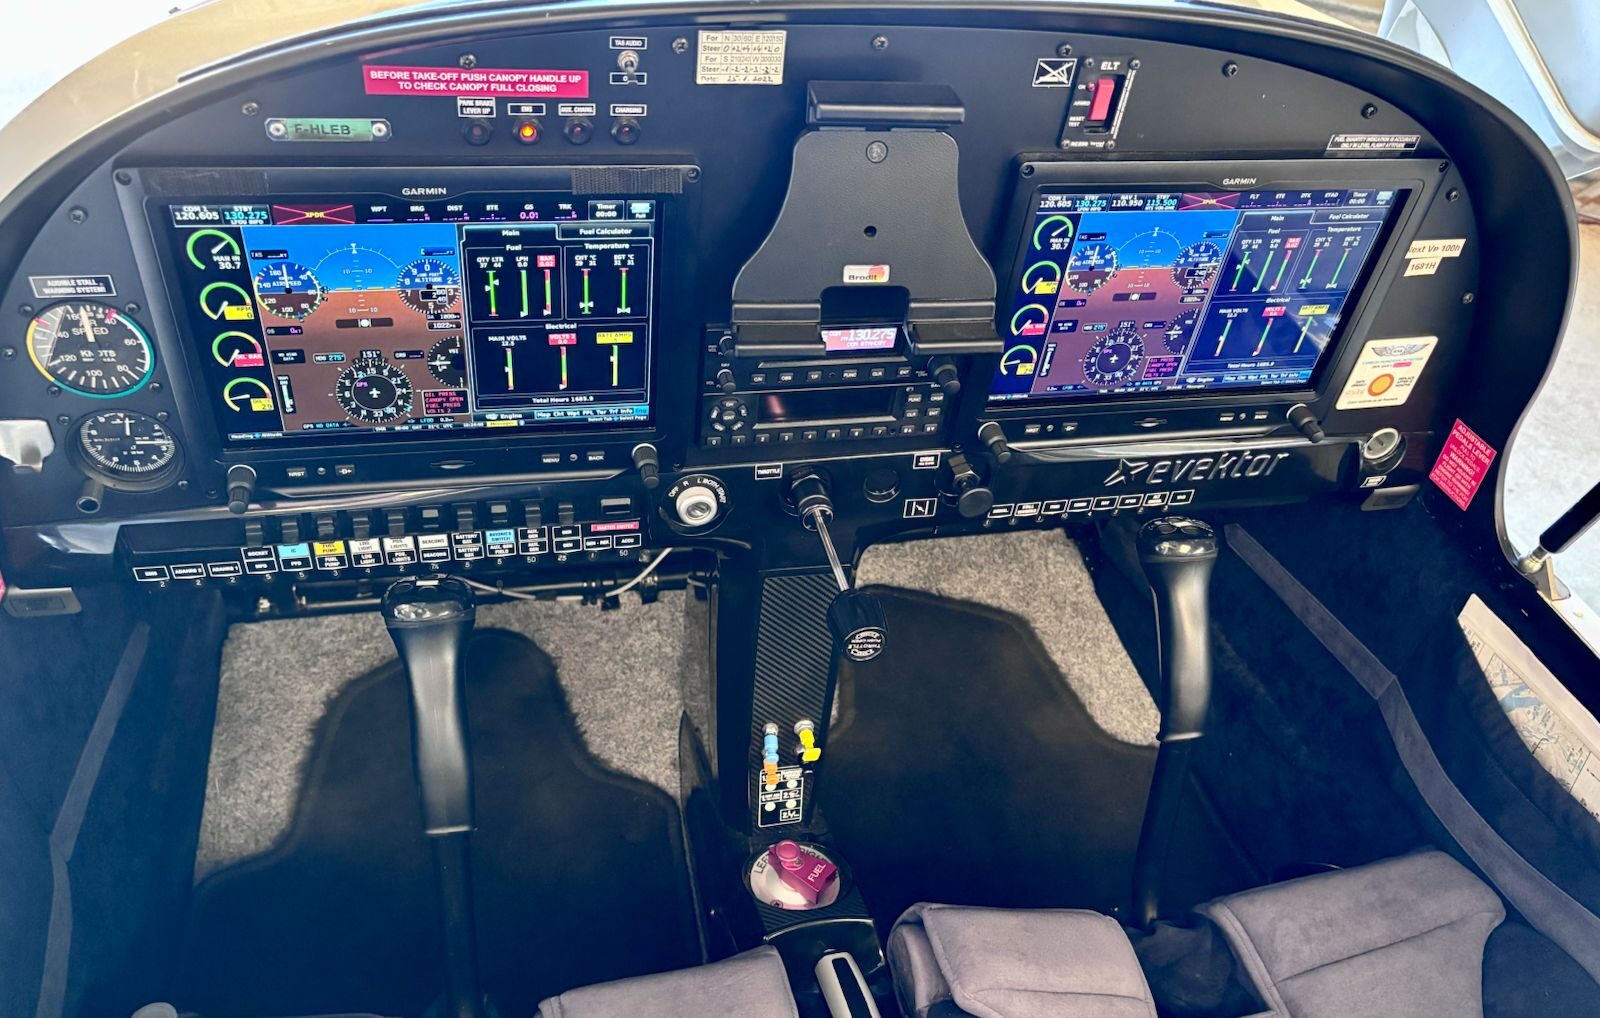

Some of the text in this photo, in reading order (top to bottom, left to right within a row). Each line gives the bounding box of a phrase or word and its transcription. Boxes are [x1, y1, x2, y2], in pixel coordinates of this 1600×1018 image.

[1101, 61, 1120, 71] ELT
[370, 71, 582, 83] BEFORE TAKE-OFF PUSH CANOPY HANDLE UP
[399, 81, 557, 93] TO CHECK CANOPY FULL CLOSING
[295, 124, 351, 135] F-HLEB
[402, 187, 447, 197] GARMIN
[1040, 200, 1072, 208] 120.605
[1075, 199, 1107, 208] 130.275
[1111, 199, 1144, 207] 110.950
[1146, 199, 1178, 207] 115.500
[371, 206, 388, 214] WPT
[175, 211, 220, 221] 120.605
[224, 211, 268, 220] 130.275
[596, 211, 618, 219] 00:00
[579, 227, 632, 236] Fuel Calculator
[506, 244, 523, 252] Fuel
[584, 243, 630, 251] Temperature
[76, 279, 98, 287] STALL
[545, 322, 577, 330] Electrical
[72, 327, 109, 336] SPED
[849, 329, 895, 341] 130.275
[124, 338, 137, 346] 60
[508, 334, 527, 342] VOLTS
[60, 355, 77, 363] 120
[362, 351, 380, 359] 151°
[117, 365, 130, 373] 80
[86, 370, 103, 378] 100
[501, 412, 523, 420] Engine
[1457, 424, 1491, 456] ADJUSTABLE
[1473, 447, 1490, 465] LEVER
[1146, 451, 1290, 484] evektor
[754, 852, 770, 874] LEF
[807, 863, 827, 883] FUEL
